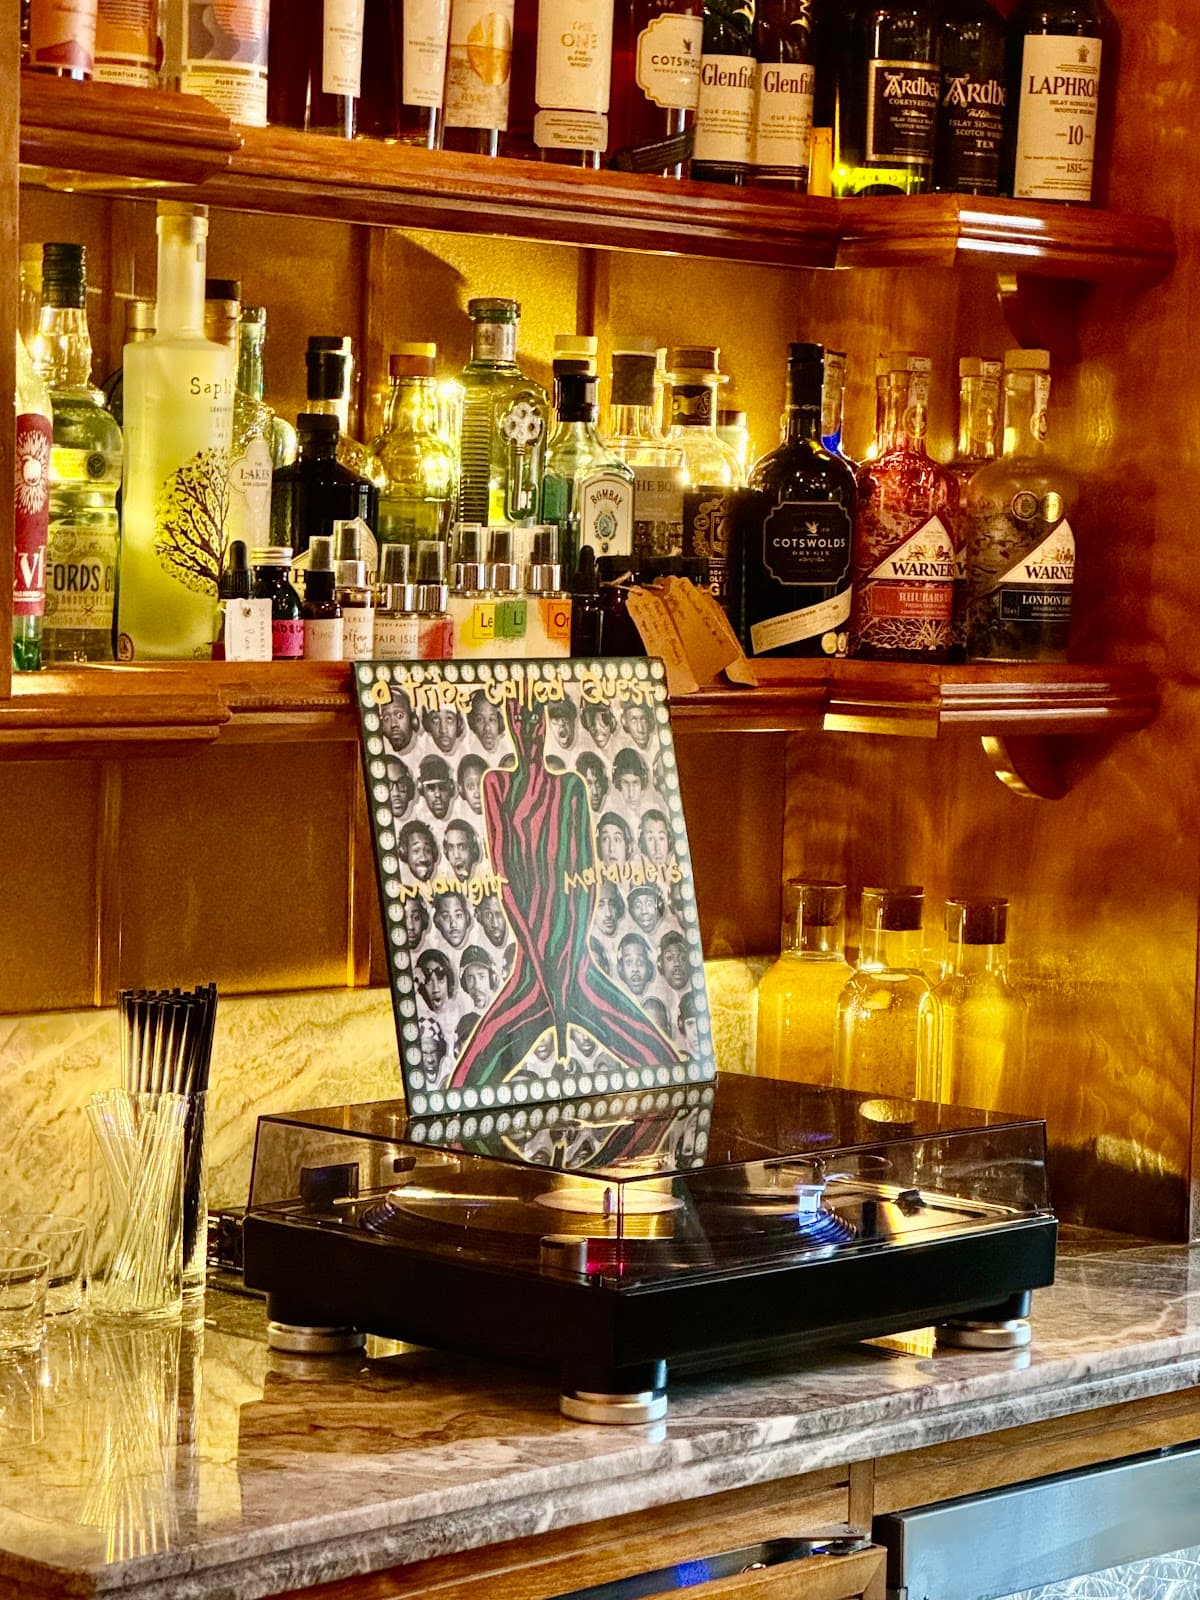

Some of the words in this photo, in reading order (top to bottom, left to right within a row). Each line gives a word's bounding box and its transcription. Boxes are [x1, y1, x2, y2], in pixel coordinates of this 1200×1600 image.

[561, 33, 598, 49] ONE
[1067, 124, 1084, 145] 10
[590, 488, 623, 506] BOMBAY
[772, 538, 846, 548] COTSWOLDS
[1022, 594, 1061, 605] LONDON
[481, 612, 493, 628] Le
[374, 634, 396, 644] FAIR
[580, 670, 656, 707] Quest
[564, 857, 684, 894] Marauders
